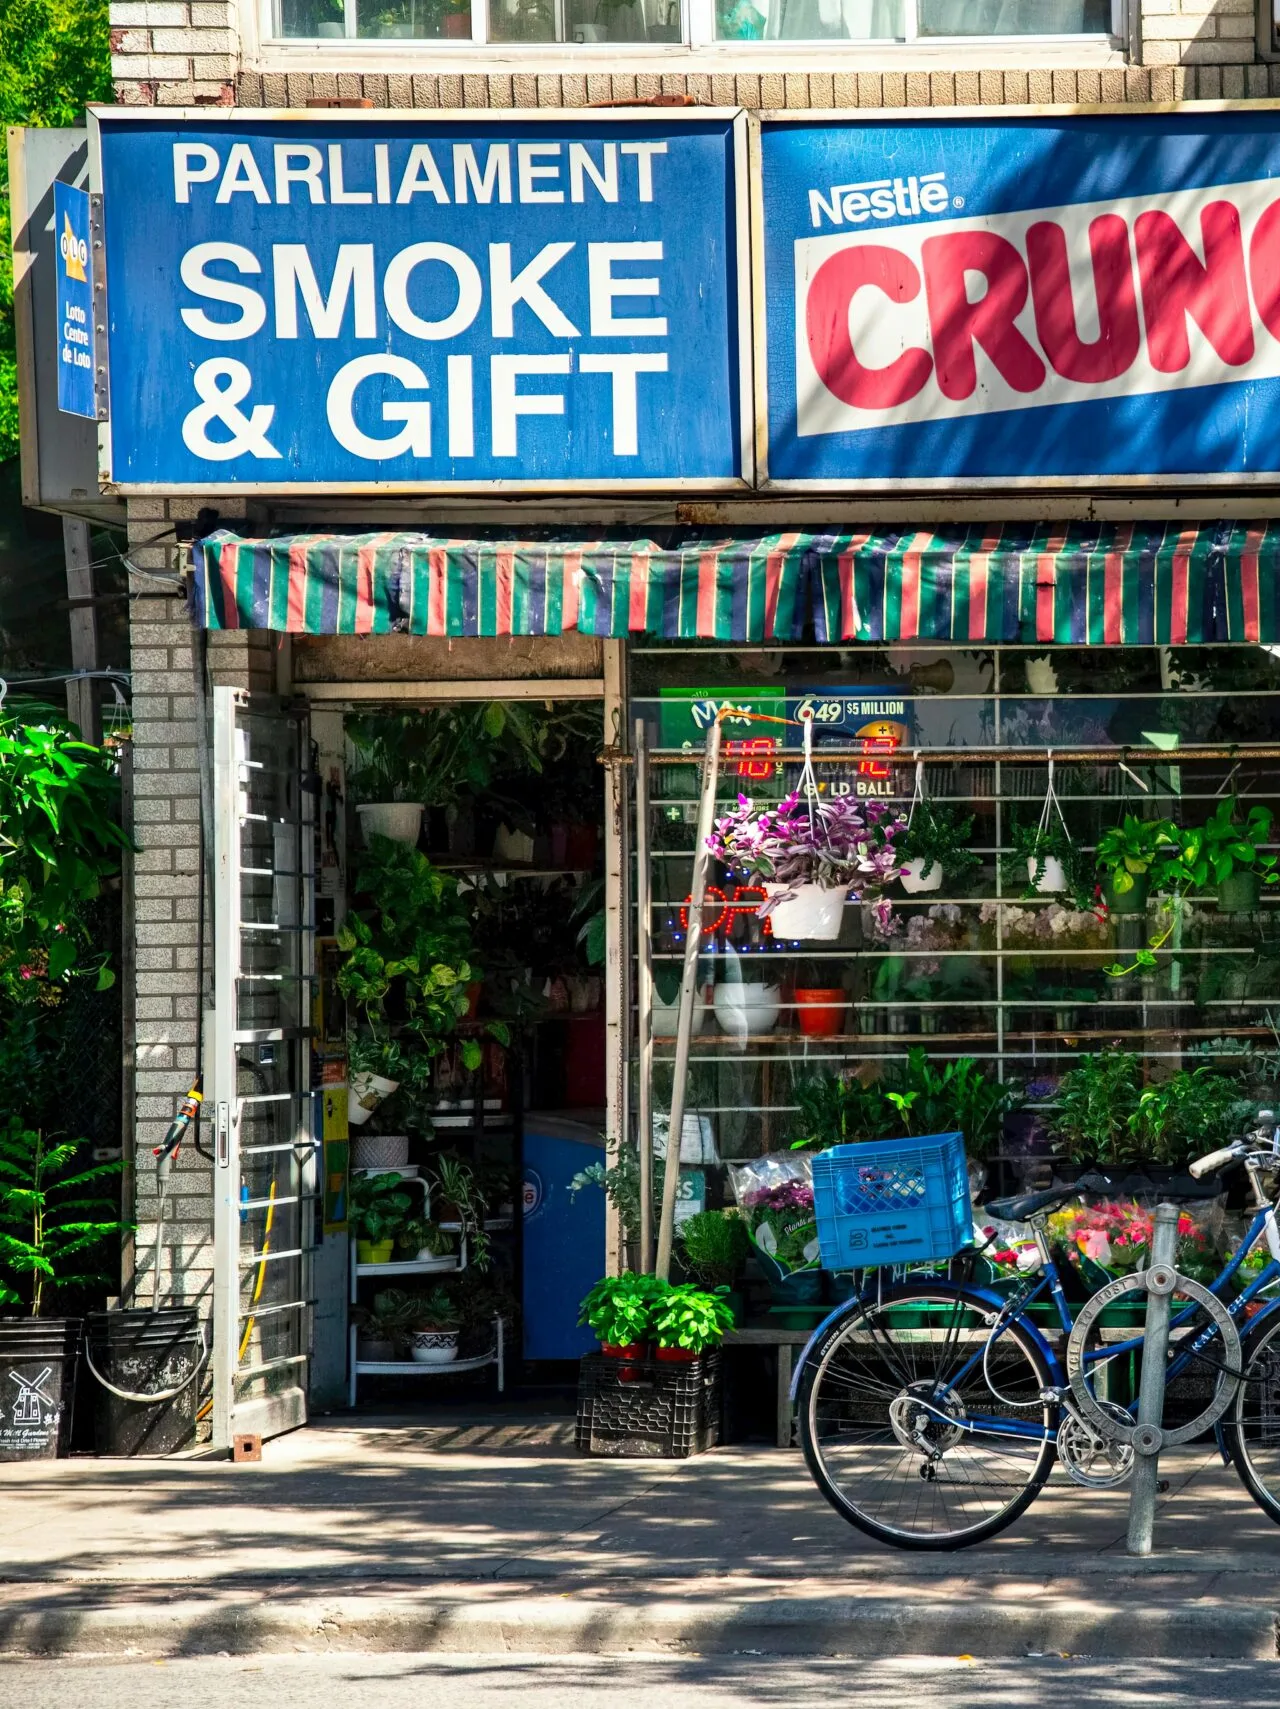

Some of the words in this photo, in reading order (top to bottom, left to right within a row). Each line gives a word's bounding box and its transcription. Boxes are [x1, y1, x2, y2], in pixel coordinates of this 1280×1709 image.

[172, 142, 668, 204] PARLIAMENT
[808, 171, 948, 228] Nestlé
[61, 240, 87, 263] OLG
[180, 241, 668, 341] SMOKE
[66, 301, 86, 324] Lotto
[63, 322, 89, 346] Centre
[62, 344, 73, 363] de
[73, 348, 91, 369] Loto
[181, 357, 283, 461] &
[326, 351, 669, 460] GIFT
[846, 702, 859, 714] $5
[861, 701, 904, 715] MILLION
[857, 781, 895, 796] BALL
[1076, 1307, 1093, 1327] TO
[1095, 1279, 1129, 1305] POST
[1191, 1294, 1248, 1351] RALGH
